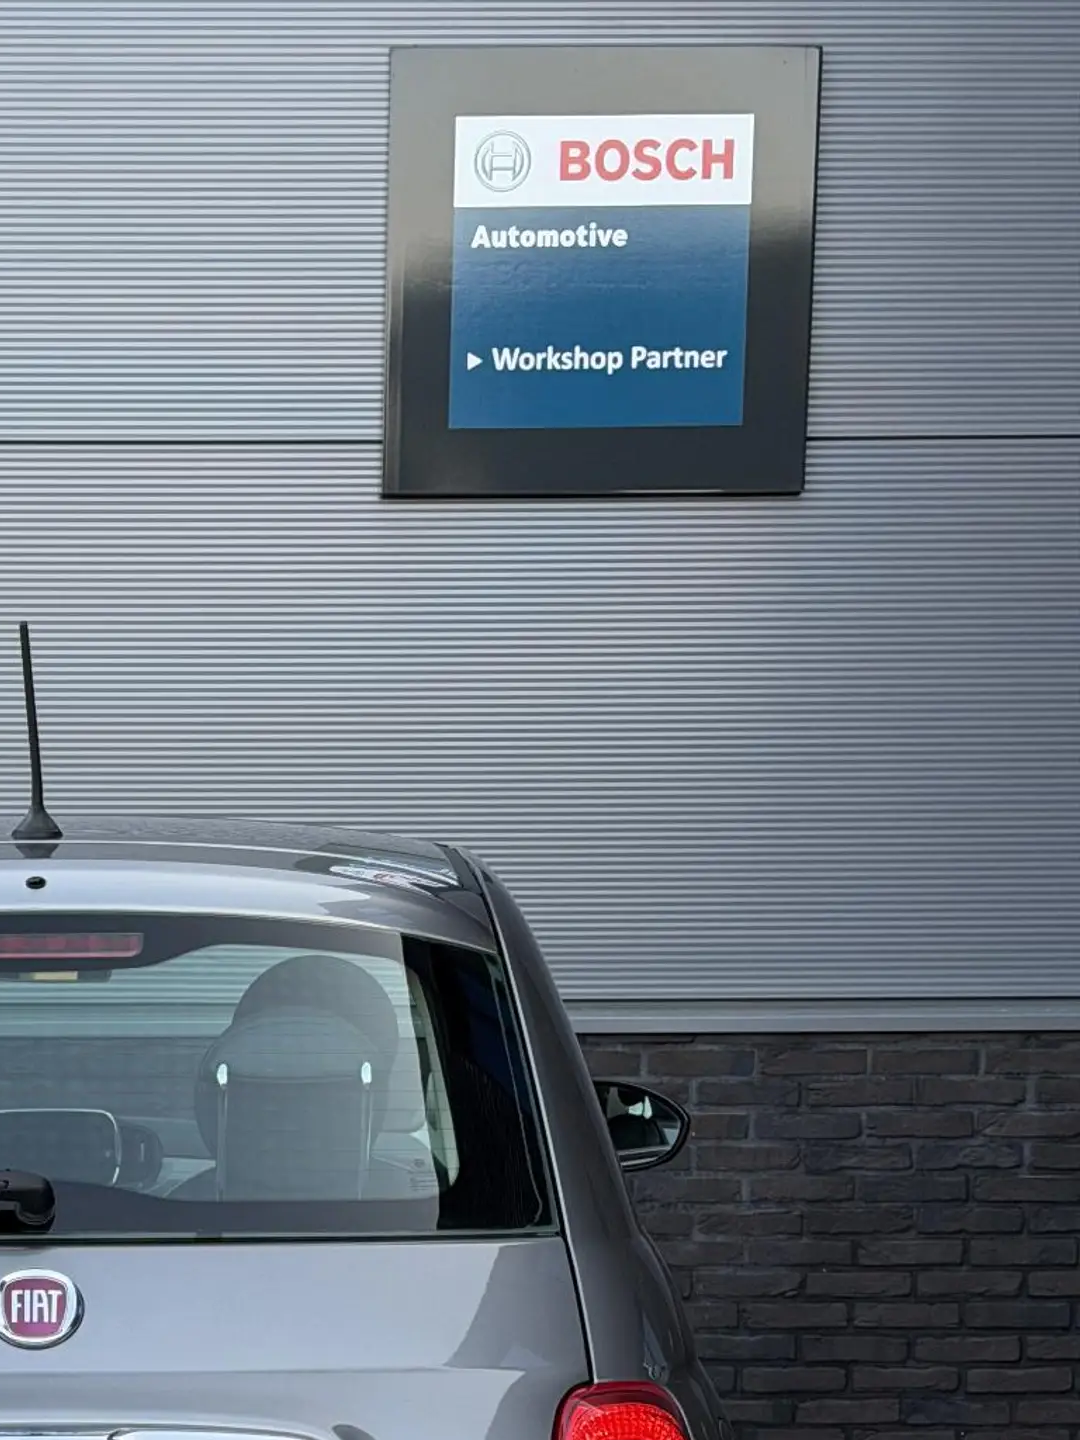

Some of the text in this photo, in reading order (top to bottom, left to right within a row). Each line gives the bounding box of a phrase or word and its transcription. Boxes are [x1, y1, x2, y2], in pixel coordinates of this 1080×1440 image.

[559, 138, 735, 181] BOSCH
[470, 222, 629, 249] Automotive
[491, 345, 728, 375] Workshop Partner
[11, 1289, 63, 1323] FIAT
